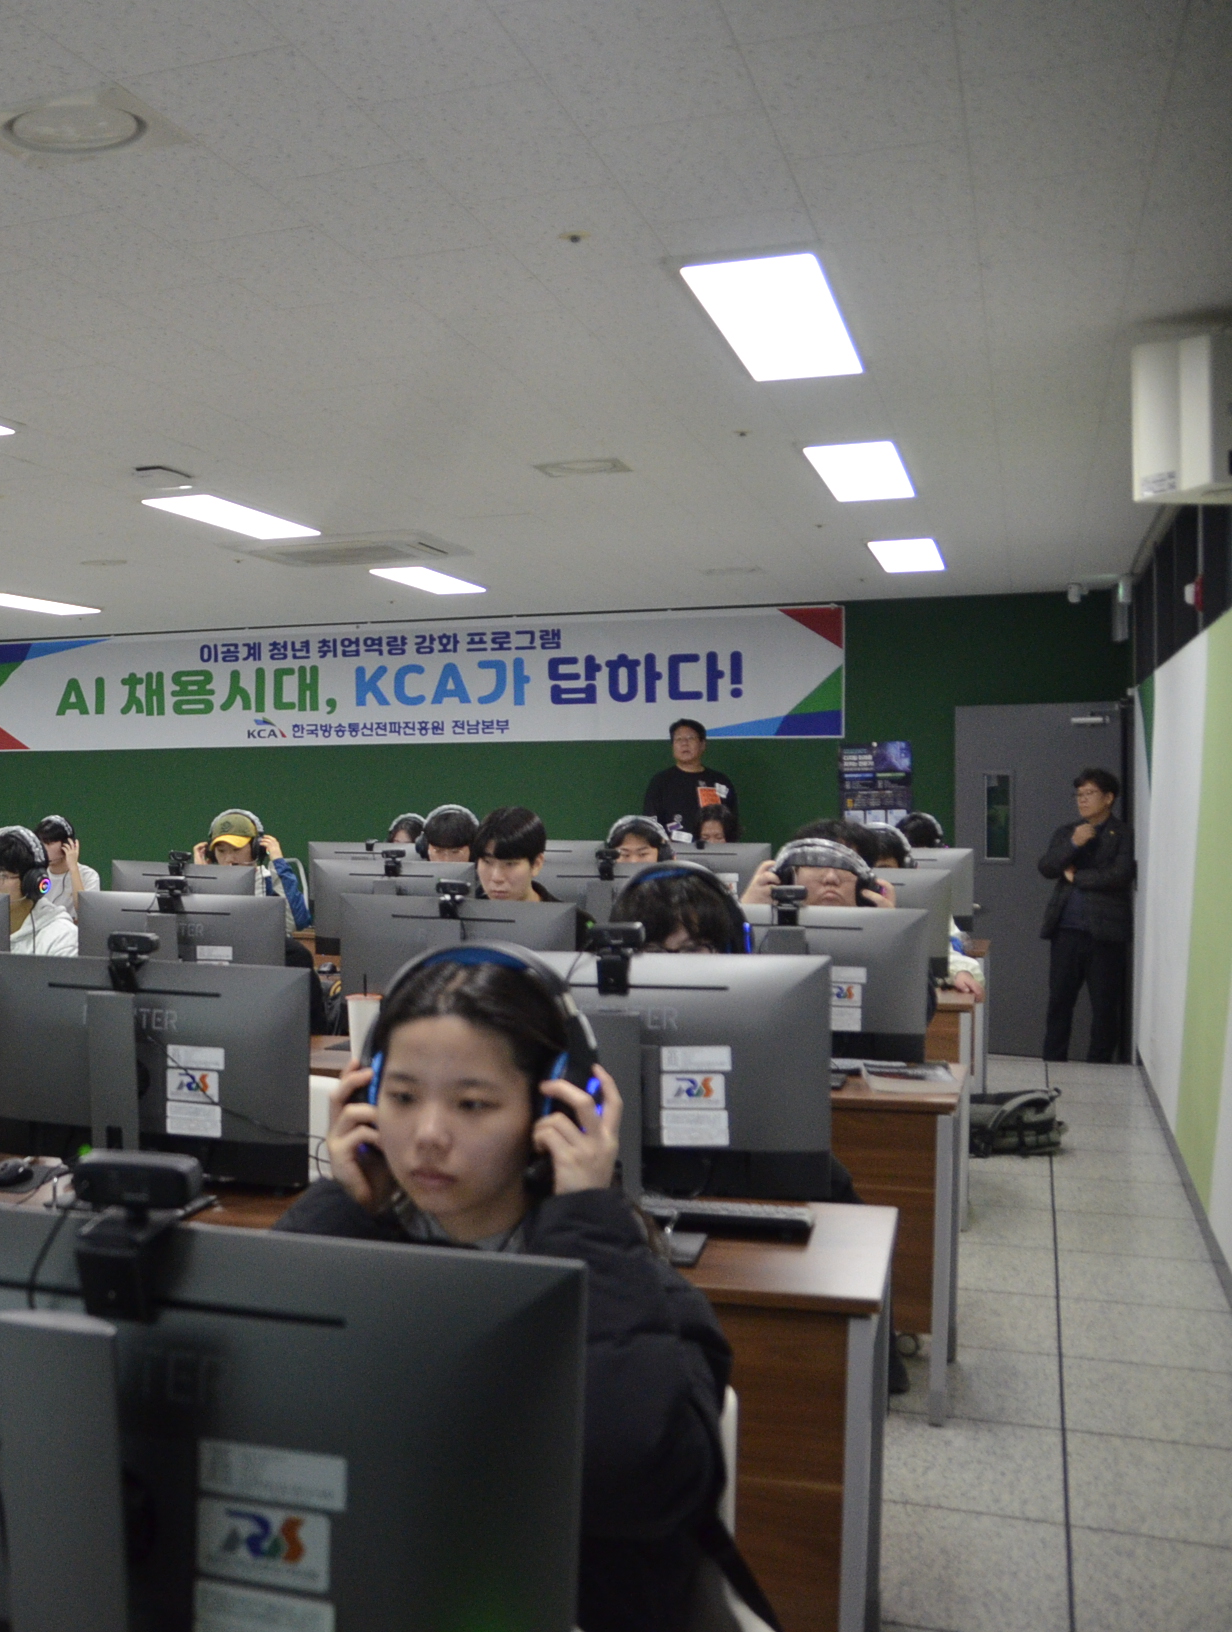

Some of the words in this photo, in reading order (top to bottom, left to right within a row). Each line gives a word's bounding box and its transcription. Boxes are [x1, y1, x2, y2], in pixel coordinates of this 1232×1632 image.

[199, 641, 263, 663] 이공계
[268, 639, 311, 661] 청년
[317, 634, 408, 659] 취업역량
[414, 632, 460, 655] 강화
[466, 628, 562, 652] 프로그램
[55, 676, 106, 716] AI
[120, 664, 338, 717] 채용시대,
[354, 656, 532, 707] KCA가
[547, 650, 745, 706] 답하다!
[247, 728, 279, 740] KCA
[291, 720, 445, 739] 한국방송통신전파진흥원
[451, 719, 510, 735] 전남본부
